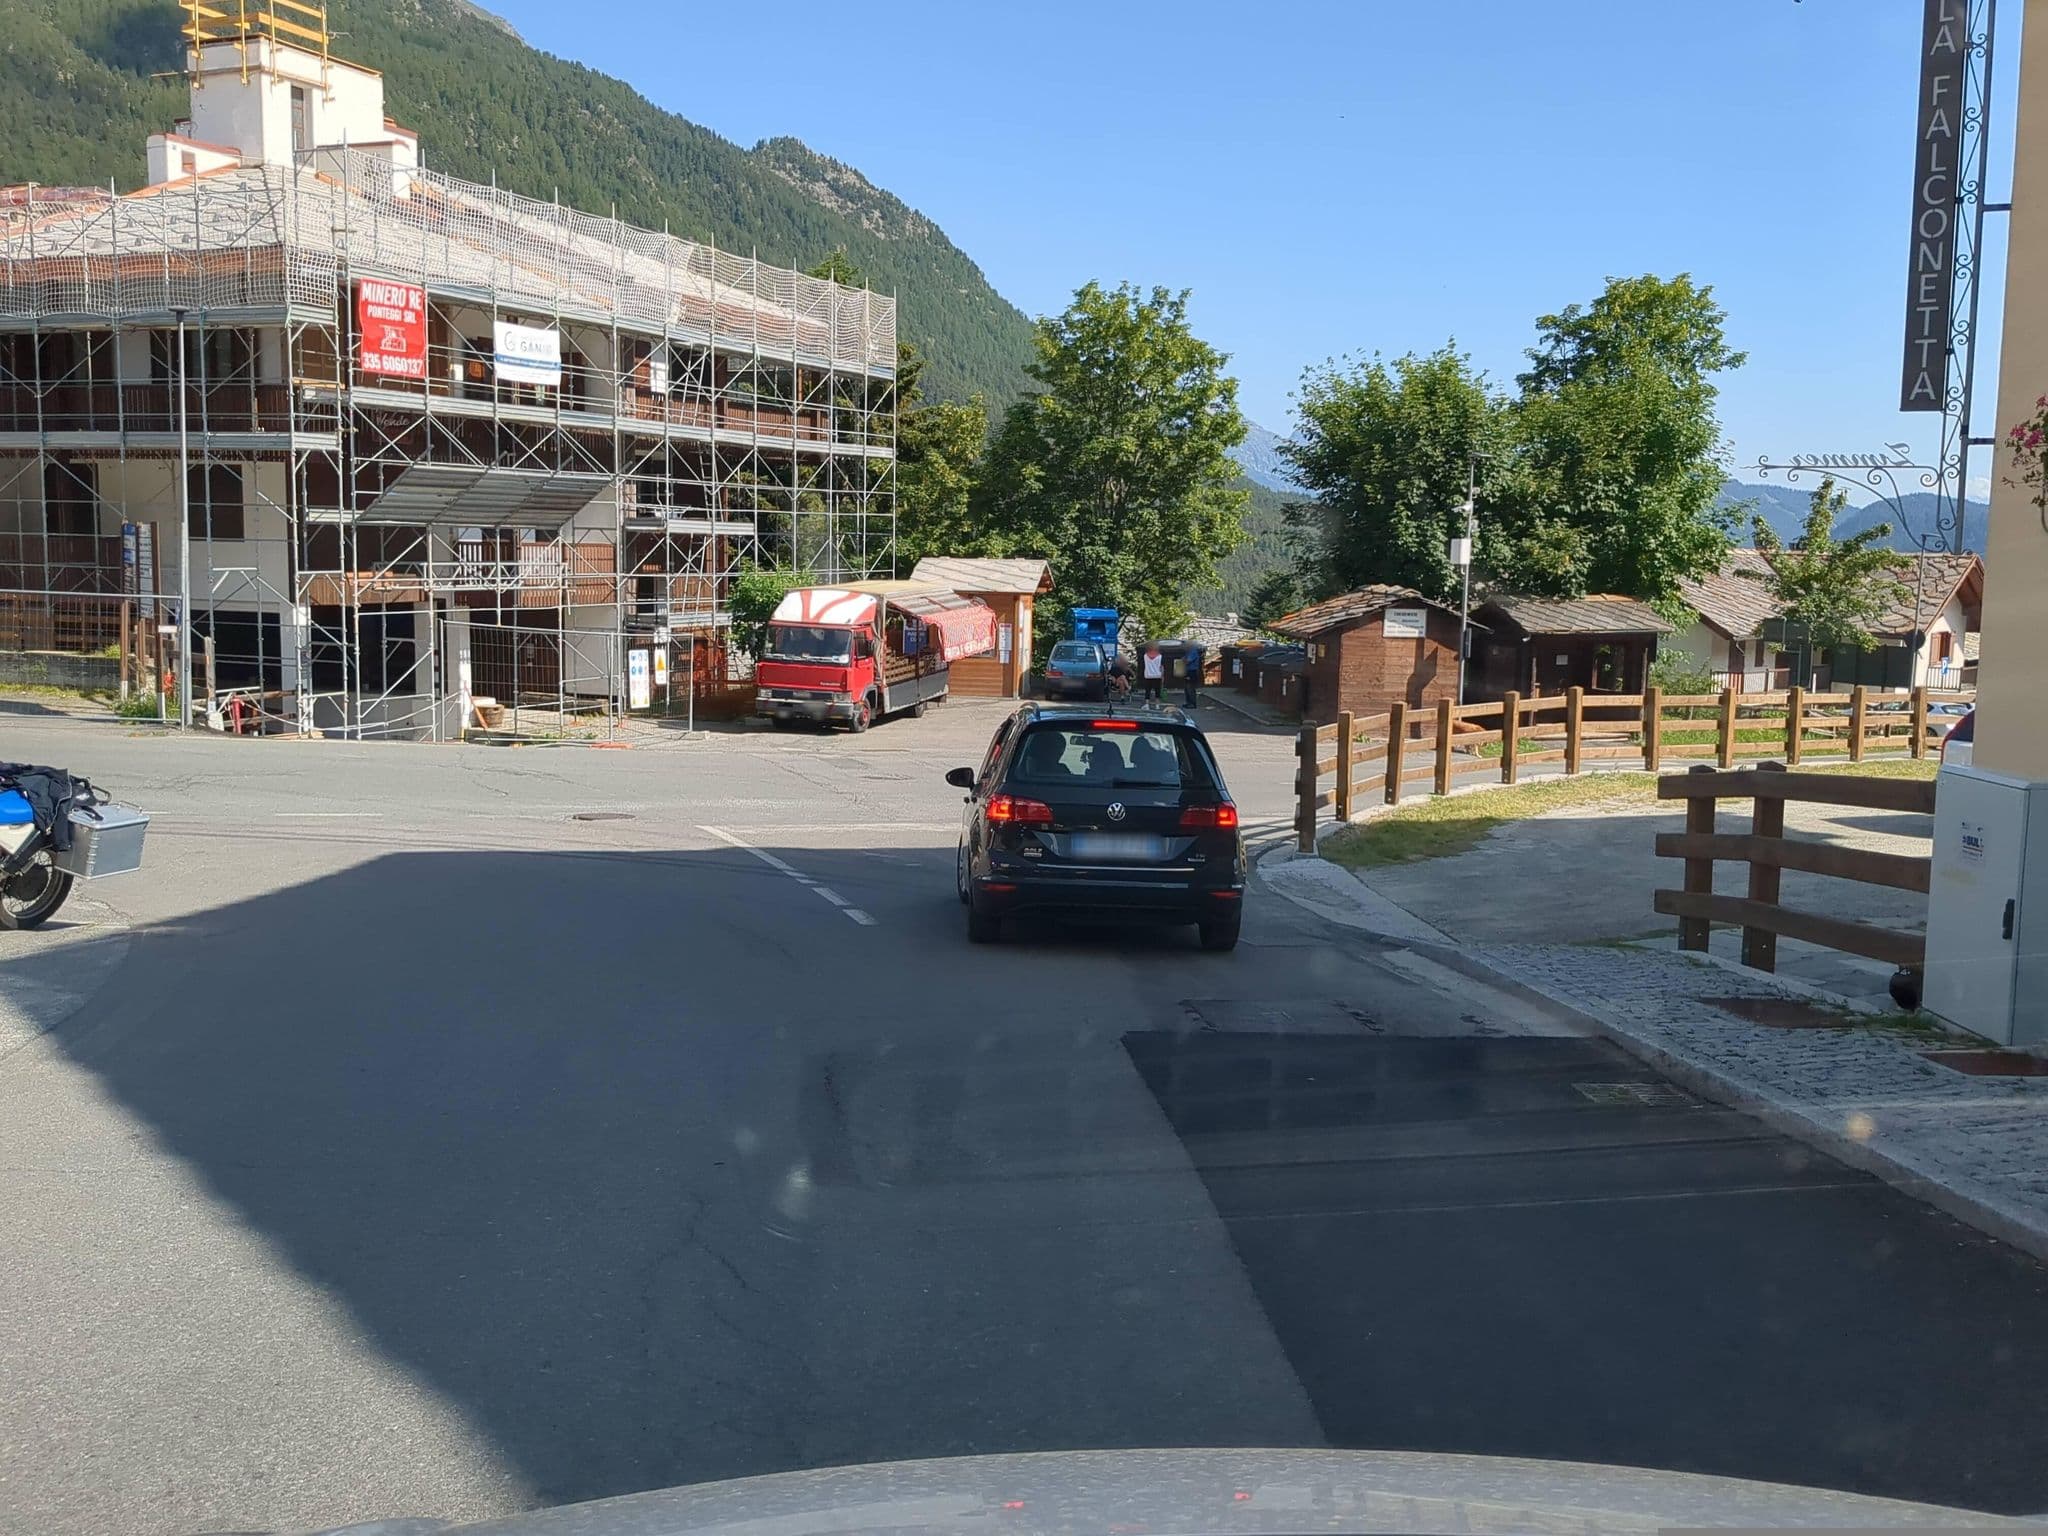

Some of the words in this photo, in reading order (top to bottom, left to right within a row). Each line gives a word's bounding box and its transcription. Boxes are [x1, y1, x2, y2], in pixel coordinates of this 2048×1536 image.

[1930, 0, 1956, 55] LA
[1909, 75, 1950, 401] FALCONETTA
[362, 281, 407, 308] MINERO
[408, 290, 423, 310] RE
[367, 304, 402, 321] PONTEGGI
[403, 310, 417, 324] SRL
[362, 351, 381, 369] 335
[382, 354, 423, 374] 6060137
